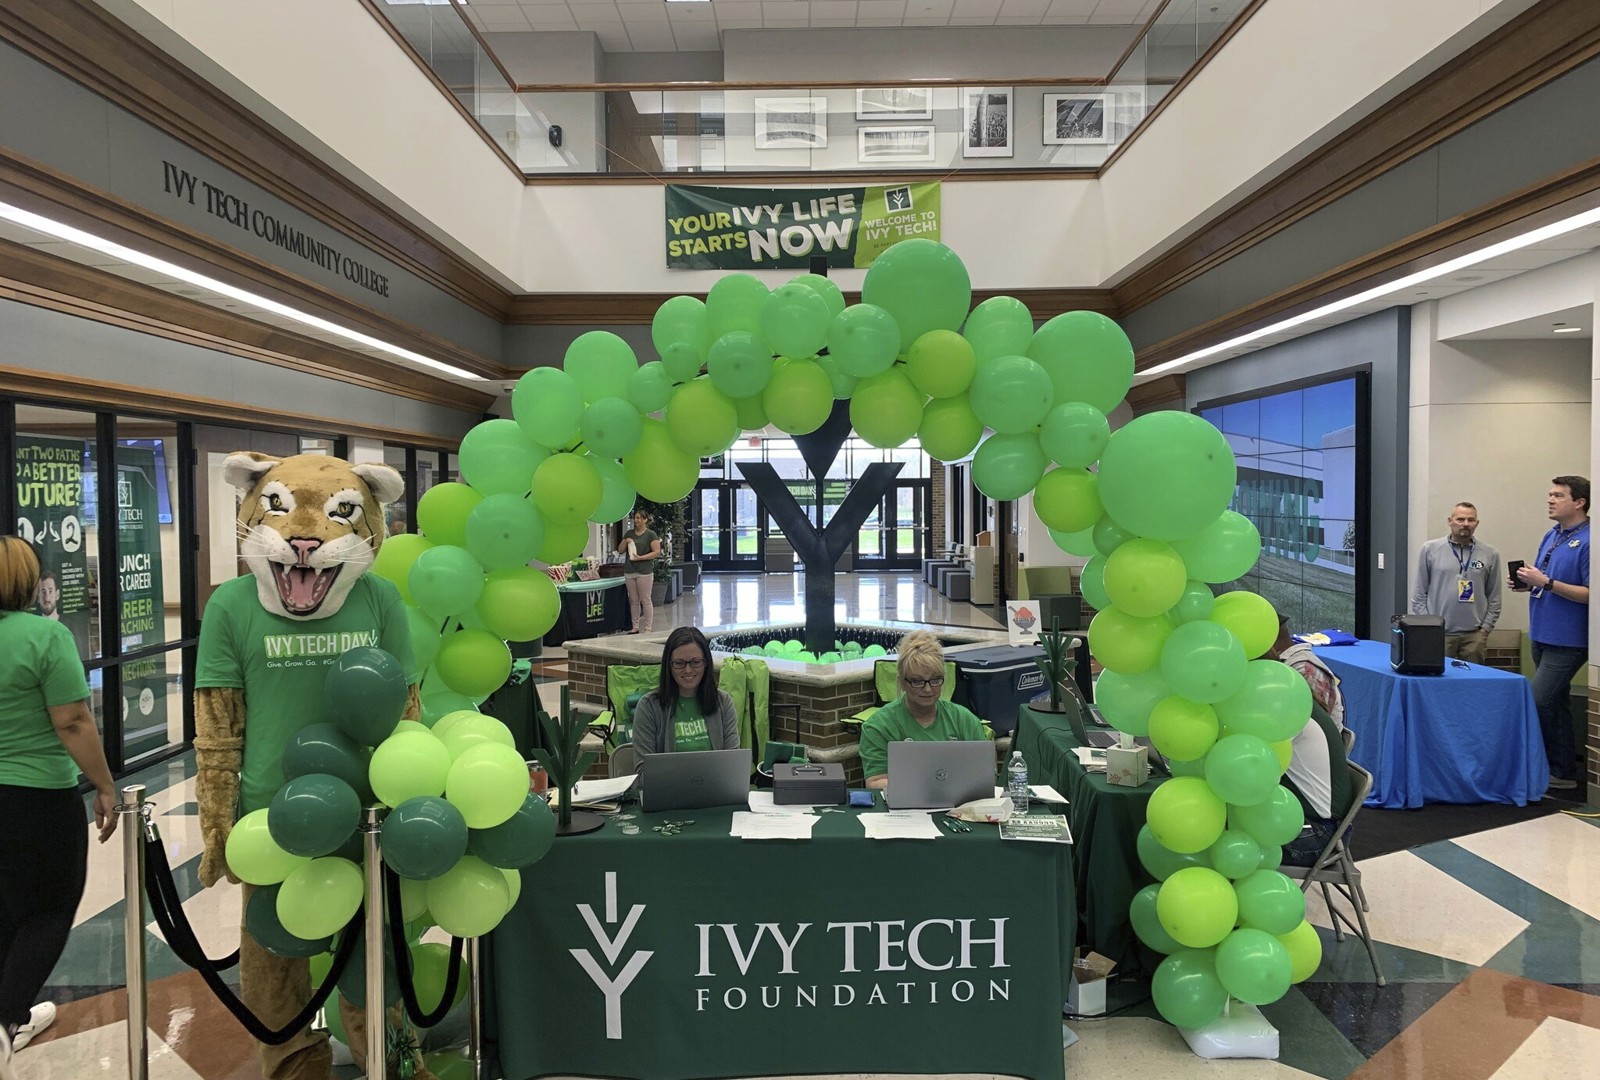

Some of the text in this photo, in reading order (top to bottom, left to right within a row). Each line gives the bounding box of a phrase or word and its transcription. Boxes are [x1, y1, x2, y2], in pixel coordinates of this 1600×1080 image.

[668, 193, 857, 235] YOUR IVY LIFE
[865, 211, 936, 229] WELCOME TO
[163, 160, 389, 298] IVY TECH COMMUNITY COLLEGE
[668, 218, 854, 262] STARTS NOW
[865, 220, 937, 240] IVY TECH!
[31, 446, 54, 460] TWO
[55, 448, 80, 462] PATHS
[23, 463, 31, 477] A
[32, 462, 81, 481] BETTER
[17, 482, 81, 508] UTURE?
[65, 522, 78, 544] 2
[125, 573, 152, 591] CAREER
[586, 604, 602, 618] LIFE
[265, 636, 292, 656] IVY
[296, 634, 337, 654] TECH
[678, 720, 703, 736] TECH
[694, 917, 1011, 976] IVY TECH
[696, 979, 1011, 1012] FOUNDATION
